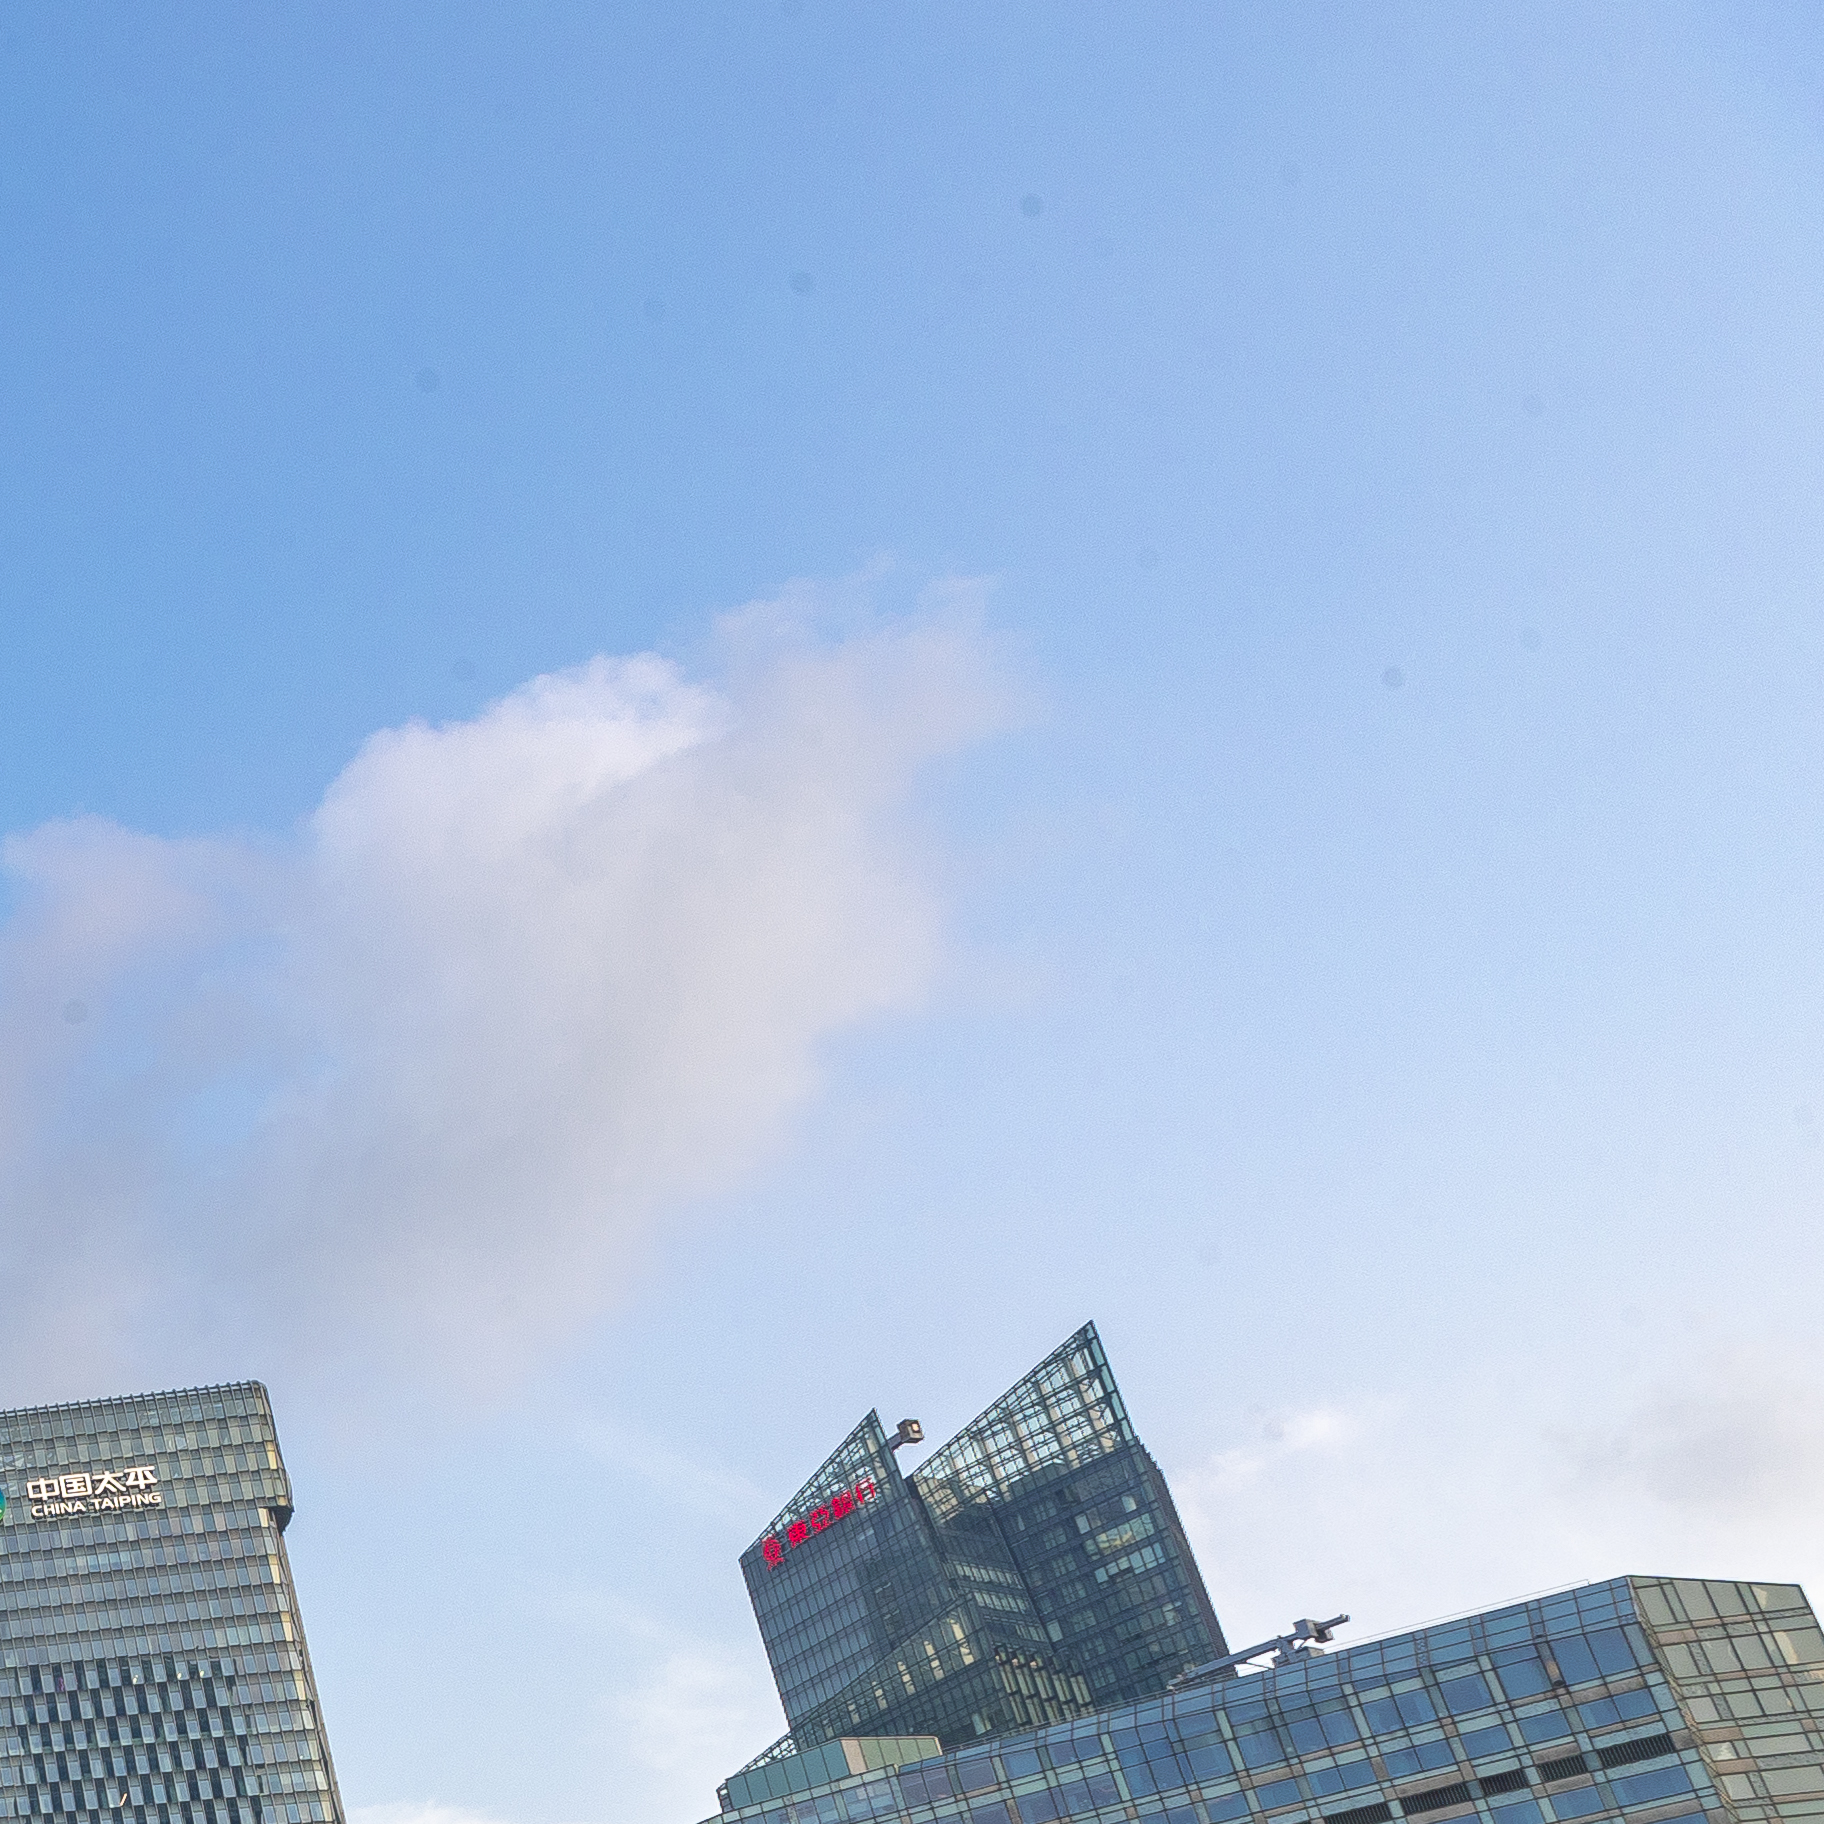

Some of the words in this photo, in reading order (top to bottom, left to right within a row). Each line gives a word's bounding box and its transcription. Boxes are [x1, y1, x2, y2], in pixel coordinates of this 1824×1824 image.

[26, 1465, 158, 1500] 中国太平
[32, 1500, 87, 1517] CHINA
[92, 1492, 162, 1510] TAIPING
